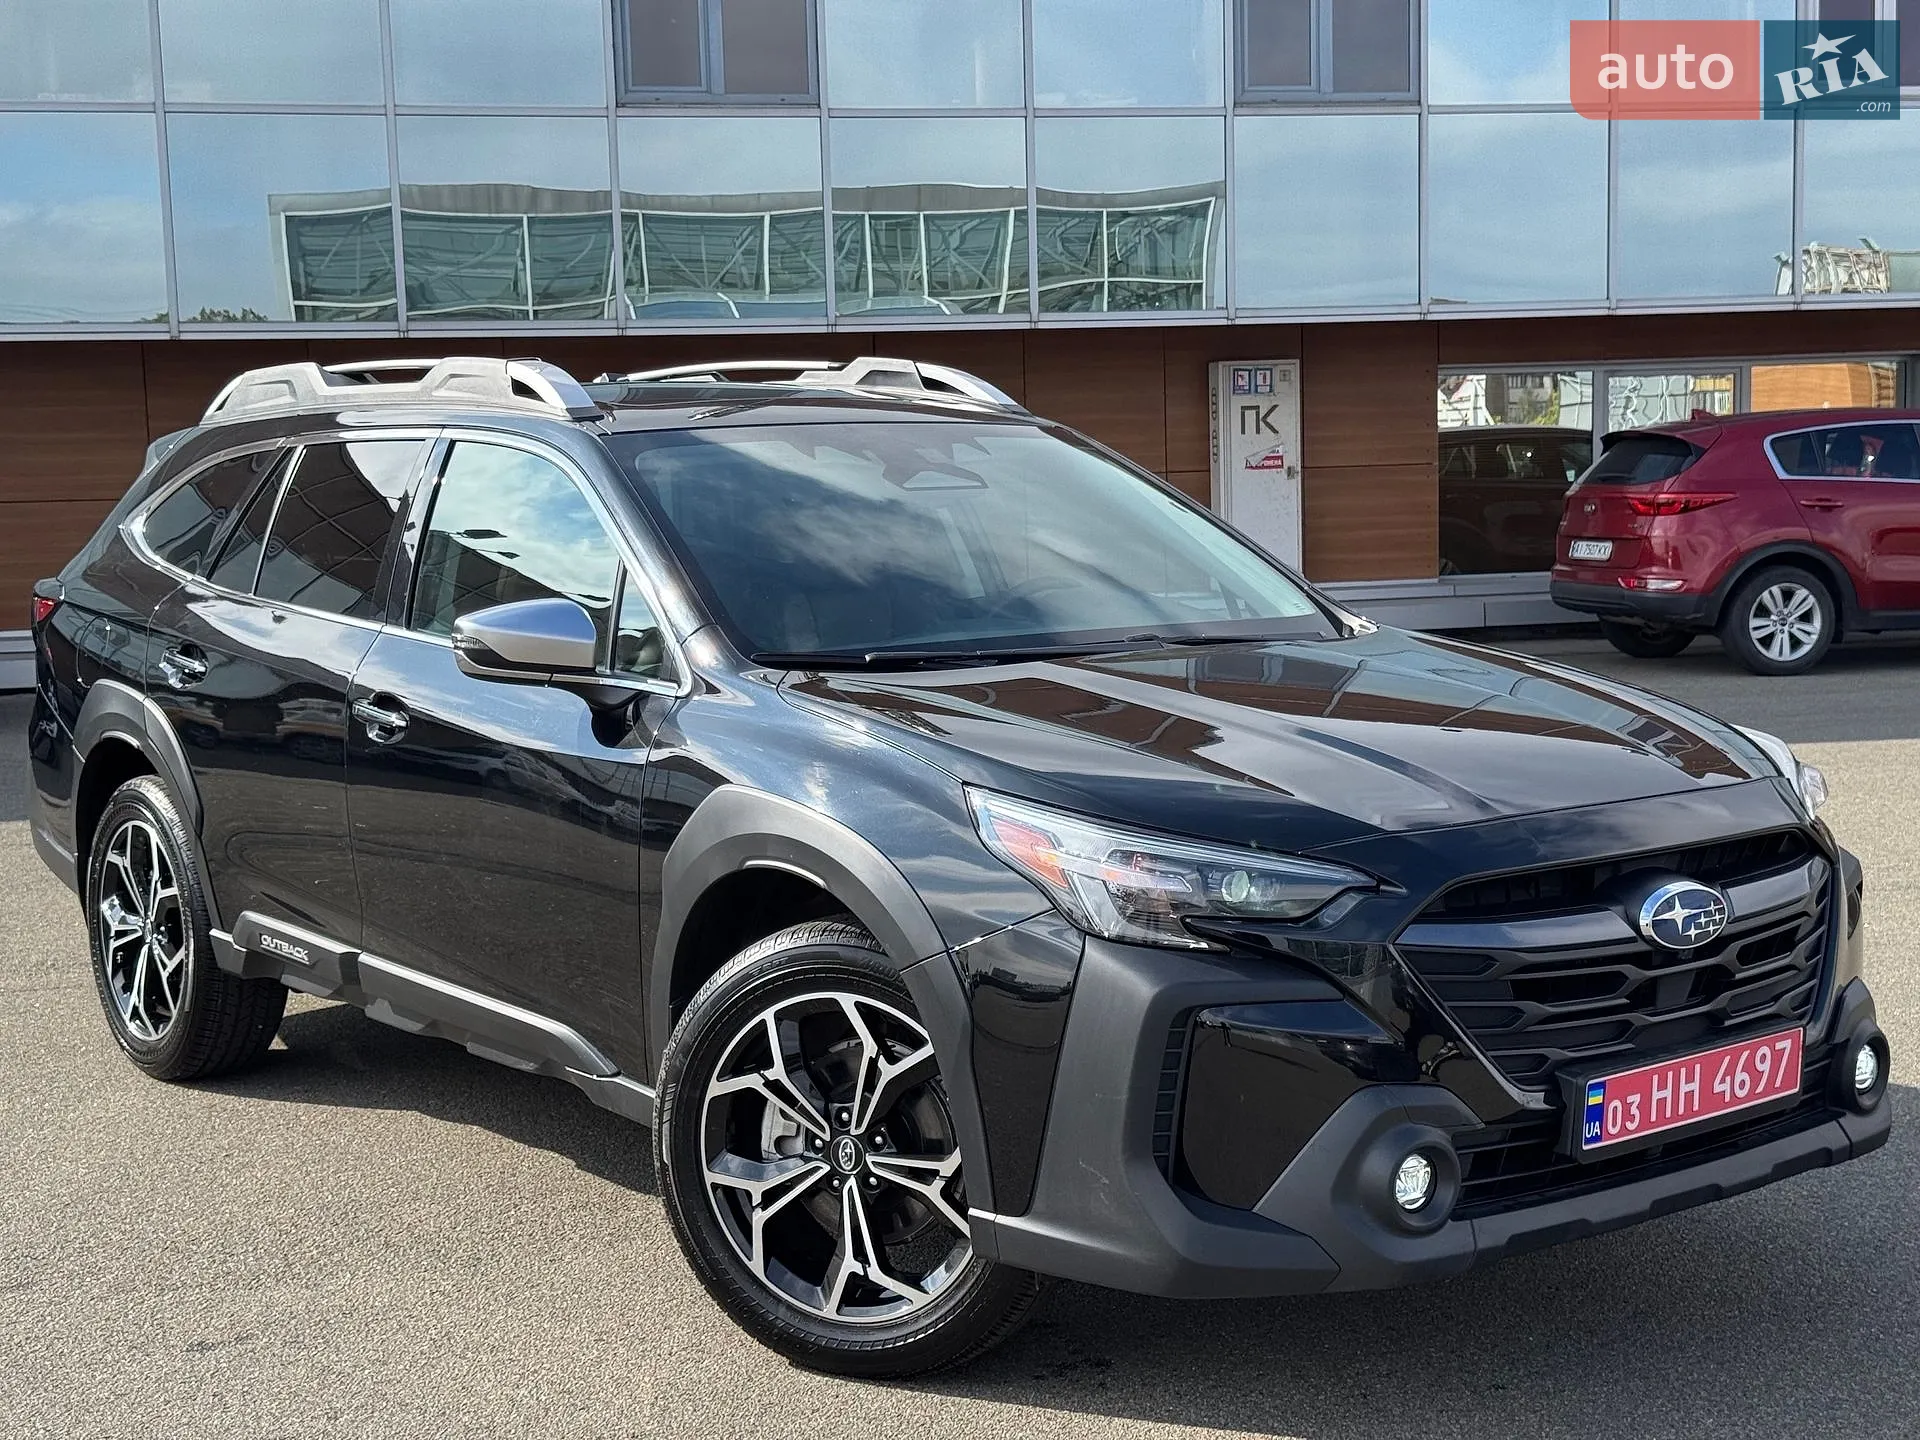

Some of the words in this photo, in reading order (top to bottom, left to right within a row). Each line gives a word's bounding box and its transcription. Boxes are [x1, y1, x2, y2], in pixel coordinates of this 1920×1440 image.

[1241, 404, 1279, 435] ПК
[260, 934, 309, 961] OUTBACK
[1606, 1092, 1641, 1136] 03
[1650, 1063, 1701, 1123] HH
[1712, 1038, 1792, 1104] 4697
[1585, 1120, 1601, 1138] UA
